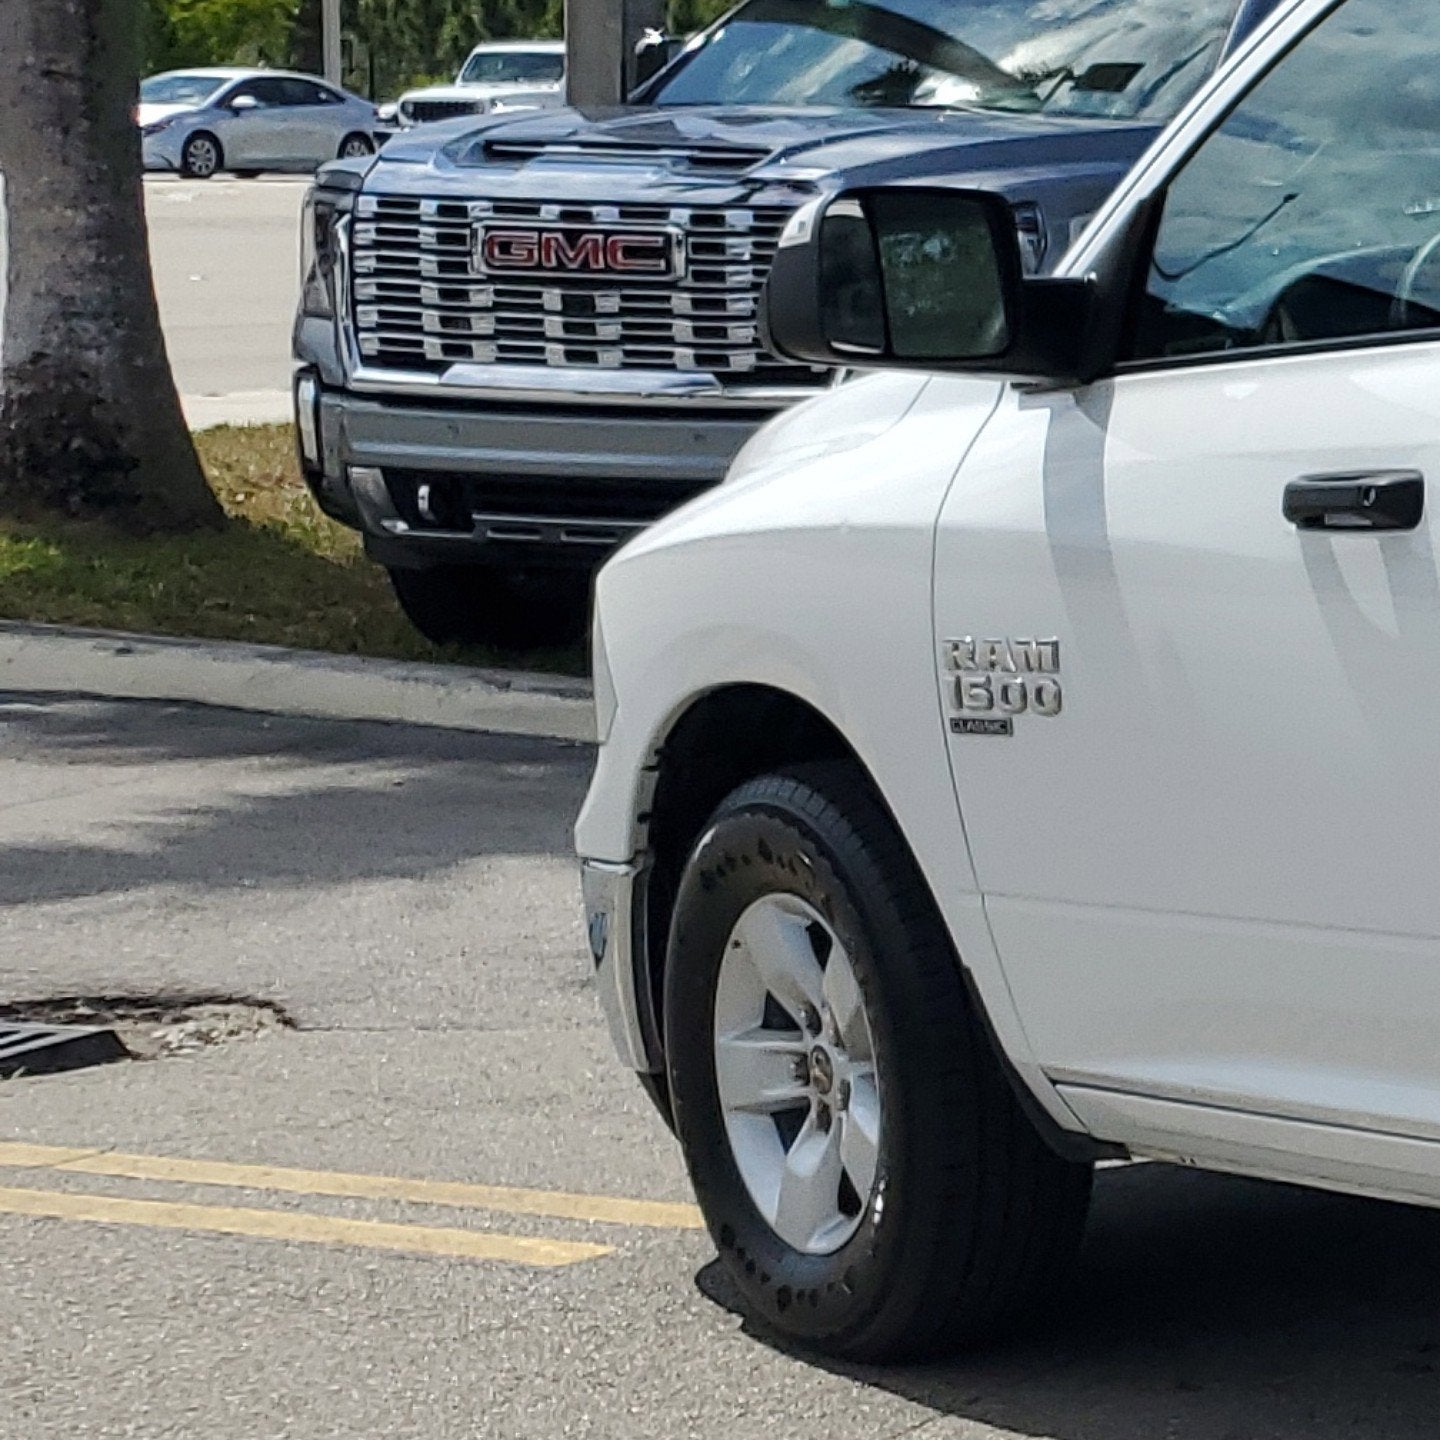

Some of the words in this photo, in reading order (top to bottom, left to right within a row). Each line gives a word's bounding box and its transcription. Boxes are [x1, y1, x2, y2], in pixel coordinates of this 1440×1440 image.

[485, 231, 667, 271] GMC
[943, 634, 1060, 675] RAM
[944, 674, 1063, 717] 1500
